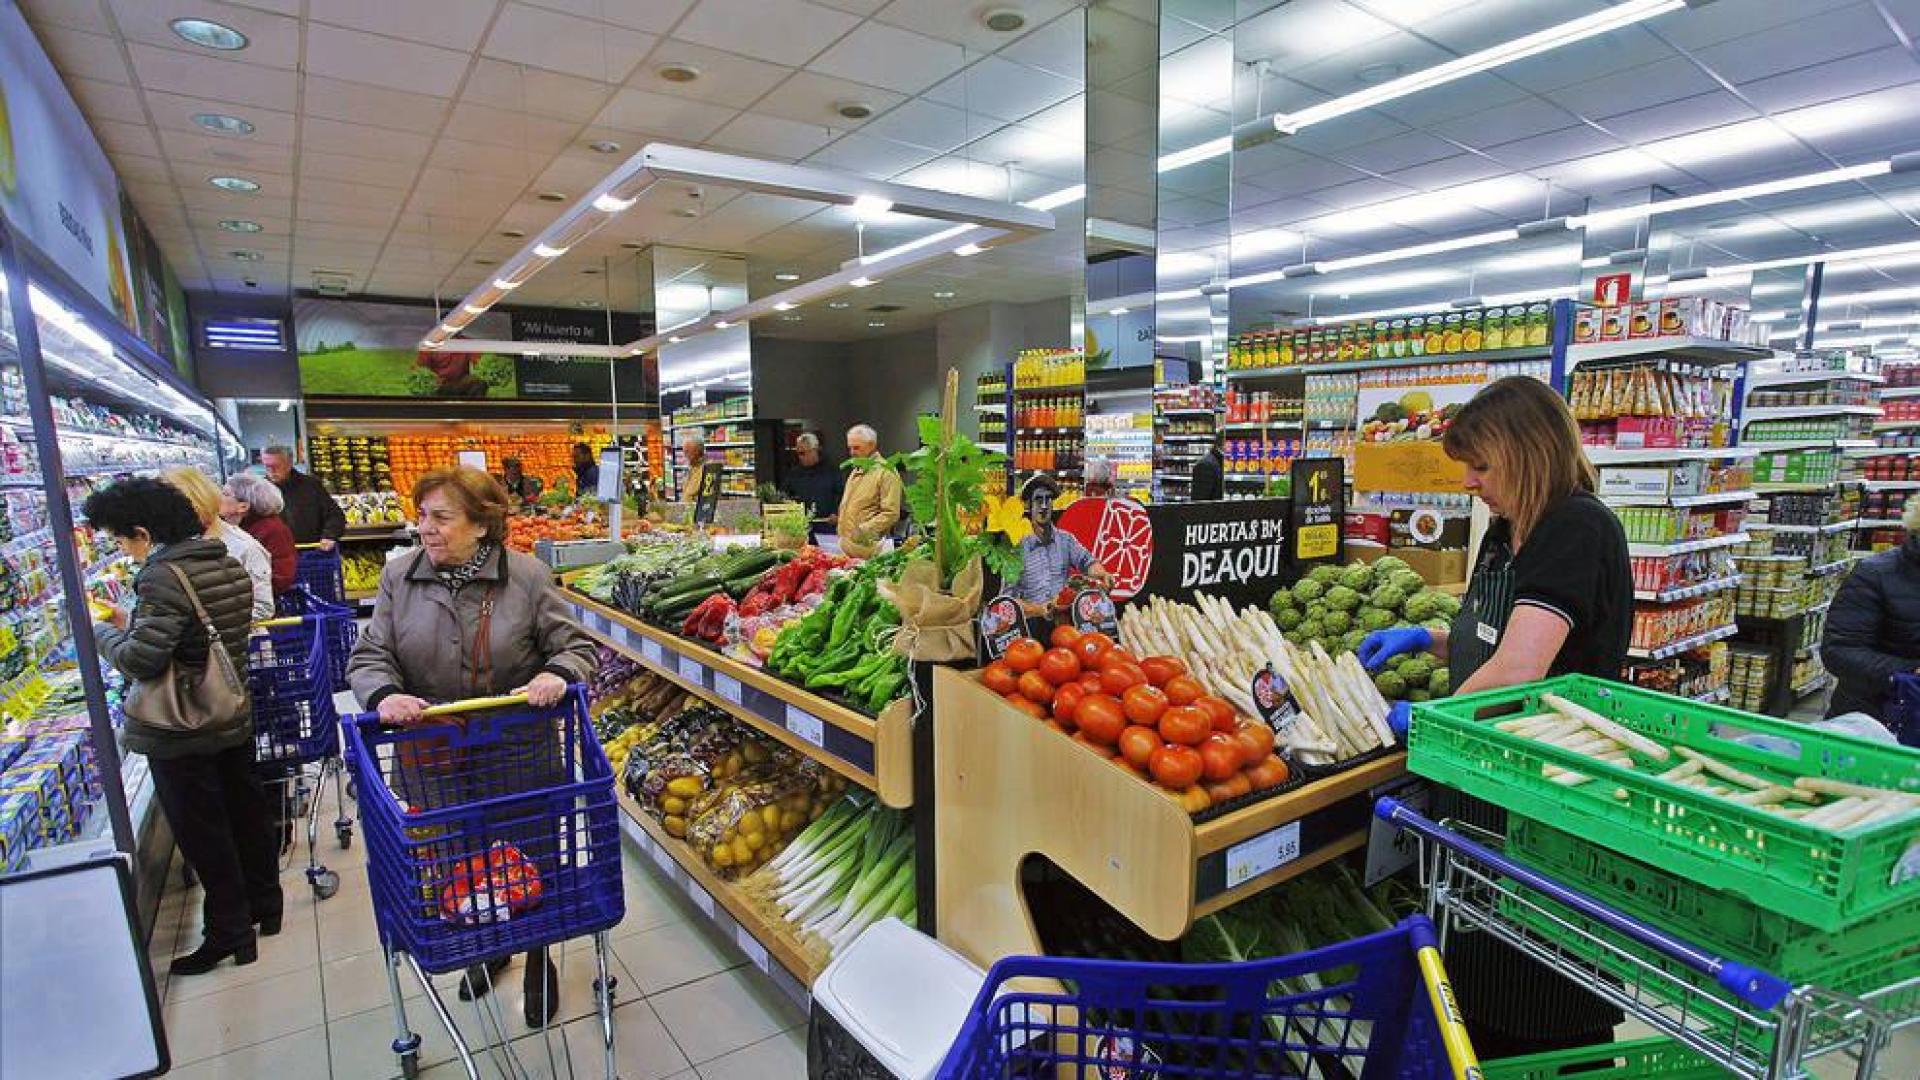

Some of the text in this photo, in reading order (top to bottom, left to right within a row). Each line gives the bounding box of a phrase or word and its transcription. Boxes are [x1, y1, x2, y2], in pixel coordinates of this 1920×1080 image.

[543, 322, 581, 336] huerta
[1185, 519, 1283, 546] HUERTAS BM
